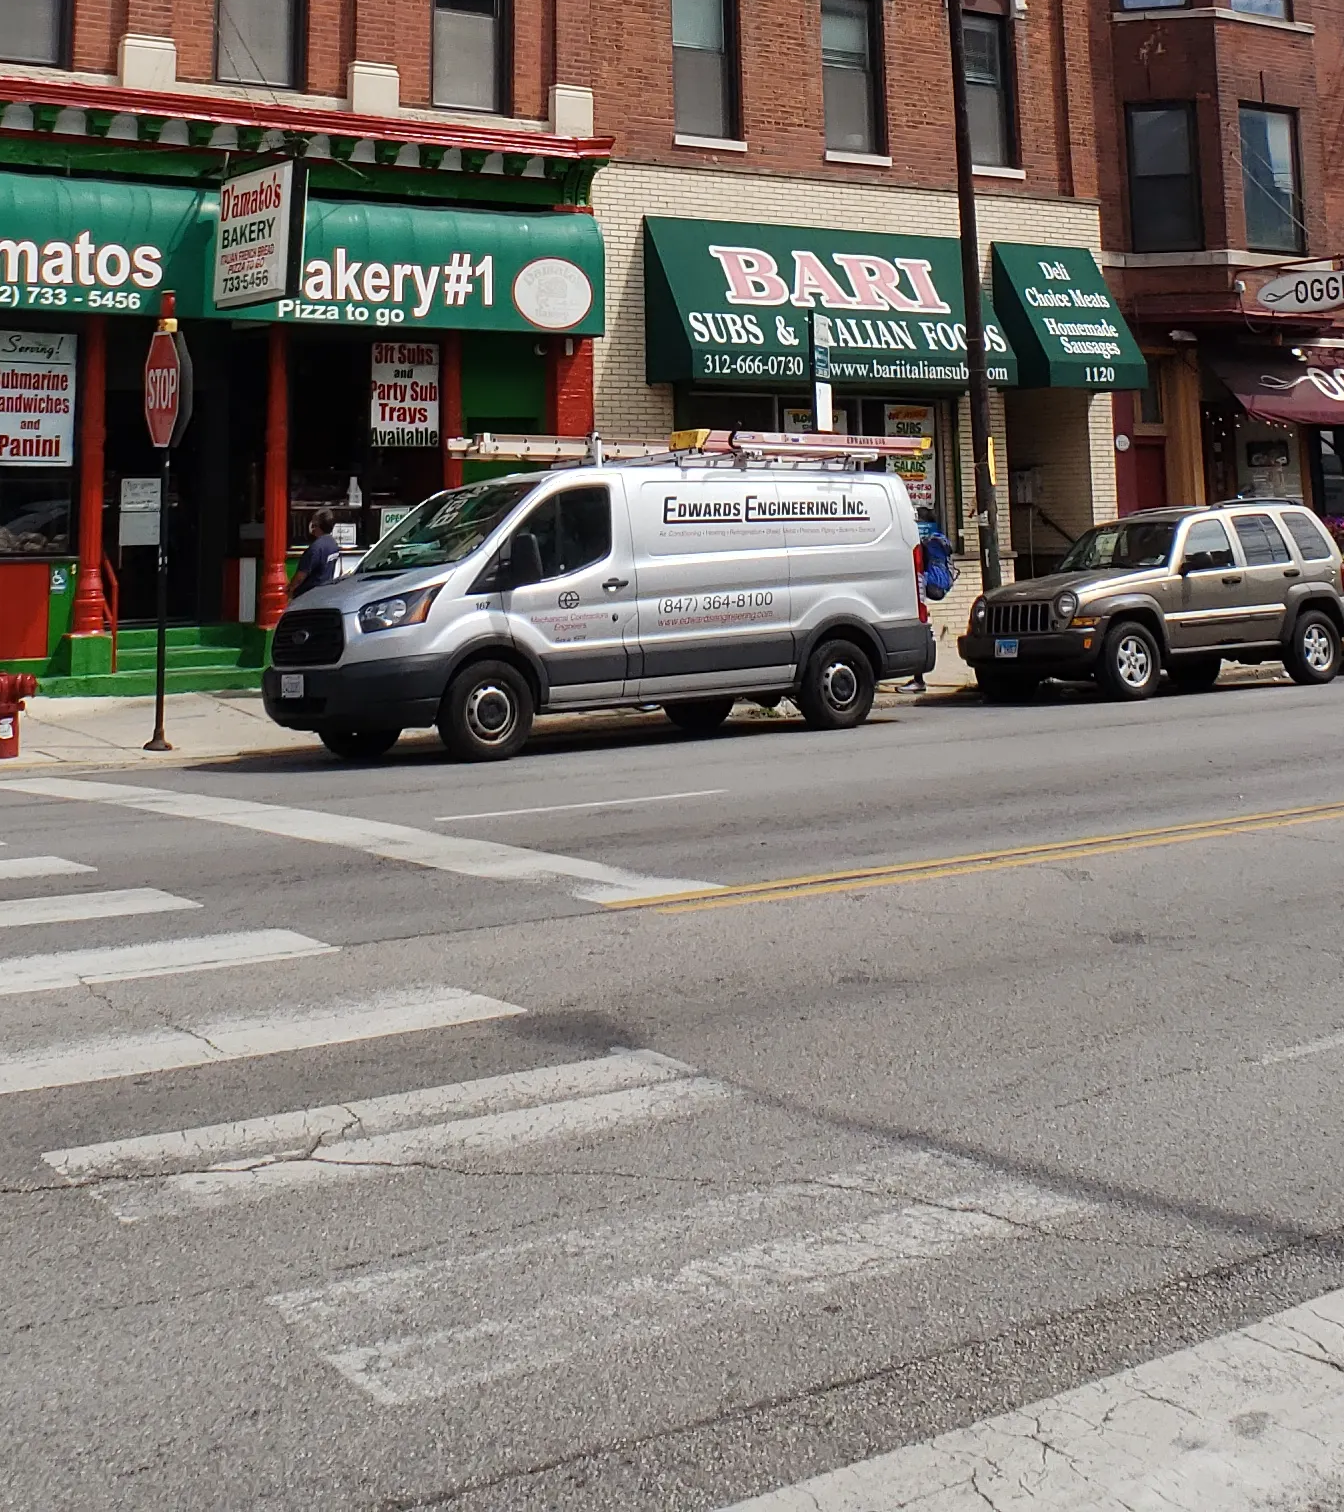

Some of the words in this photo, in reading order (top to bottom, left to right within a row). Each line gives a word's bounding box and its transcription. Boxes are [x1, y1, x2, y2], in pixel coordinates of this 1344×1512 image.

[221, 172, 281, 222] D'amato's
[222, 217, 276, 250] BAKERY
[239, 248, 257, 262] FRENCH
[257, 244, 275, 258] BREAD
[227, 262, 245, 275] PIZZA
[246, 260, 255, 272] TO
[255, 257, 265, 269] GO
[1038, 261, 1071, 280] Deli
[223, 270, 269, 294] 733-5456
[305, 247, 440, 318] akery
[709, 245, 951, 314] BARI
[27, 287, 68, 306] 733
[88, 291, 141, 310] 5456
[1025, 287, 1071, 307] Choice
[1068, 289, 1111, 308] Meats
[277, 299, 339, 320] Pizza
[345, 303, 369, 321] to
[375, 307, 405, 326] go
[688, 312, 765, 345] SUBS
[775, 315, 799, 346] &
[1042, 317, 1119, 337] Homemade
[1, 334, 64, 359] Serving!
[374, 343, 395, 364] 3ft
[398, 344, 433, 365] Subs
[1059, 336, 1120, 360] Sausages
[394, 368, 413, 379] and
[704, 354, 803, 375] 312-666-0730
[830, 359, 1008, 381] www.bariitaliansubom
[1085, 367, 1115, 382] 1120
[147, 368, 177, 410] STOP
[371, 380, 407, 403] Party
[410, 381, 438, 401] Sub
[20, 419, 41, 430] and
[379, 403, 428, 424] Trays
[371, 427, 438, 446] Available
[896, 421, 922, 434] SUBS
[894, 461, 926, 473] SALADS
[663, 496, 742, 523] EDWARDS
[745, 496, 838, 522] ENGINEERING
[842, 495, 868, 517] INC.
[657, 597, 698, 615] (847)
[702, 591, 773, 611] 364-8100
[531, 615, 568, 623] Mechanical
[570, 612, 609, 621] Contractors
[657, 610, 773, 627] www.edwardsengineering.com
